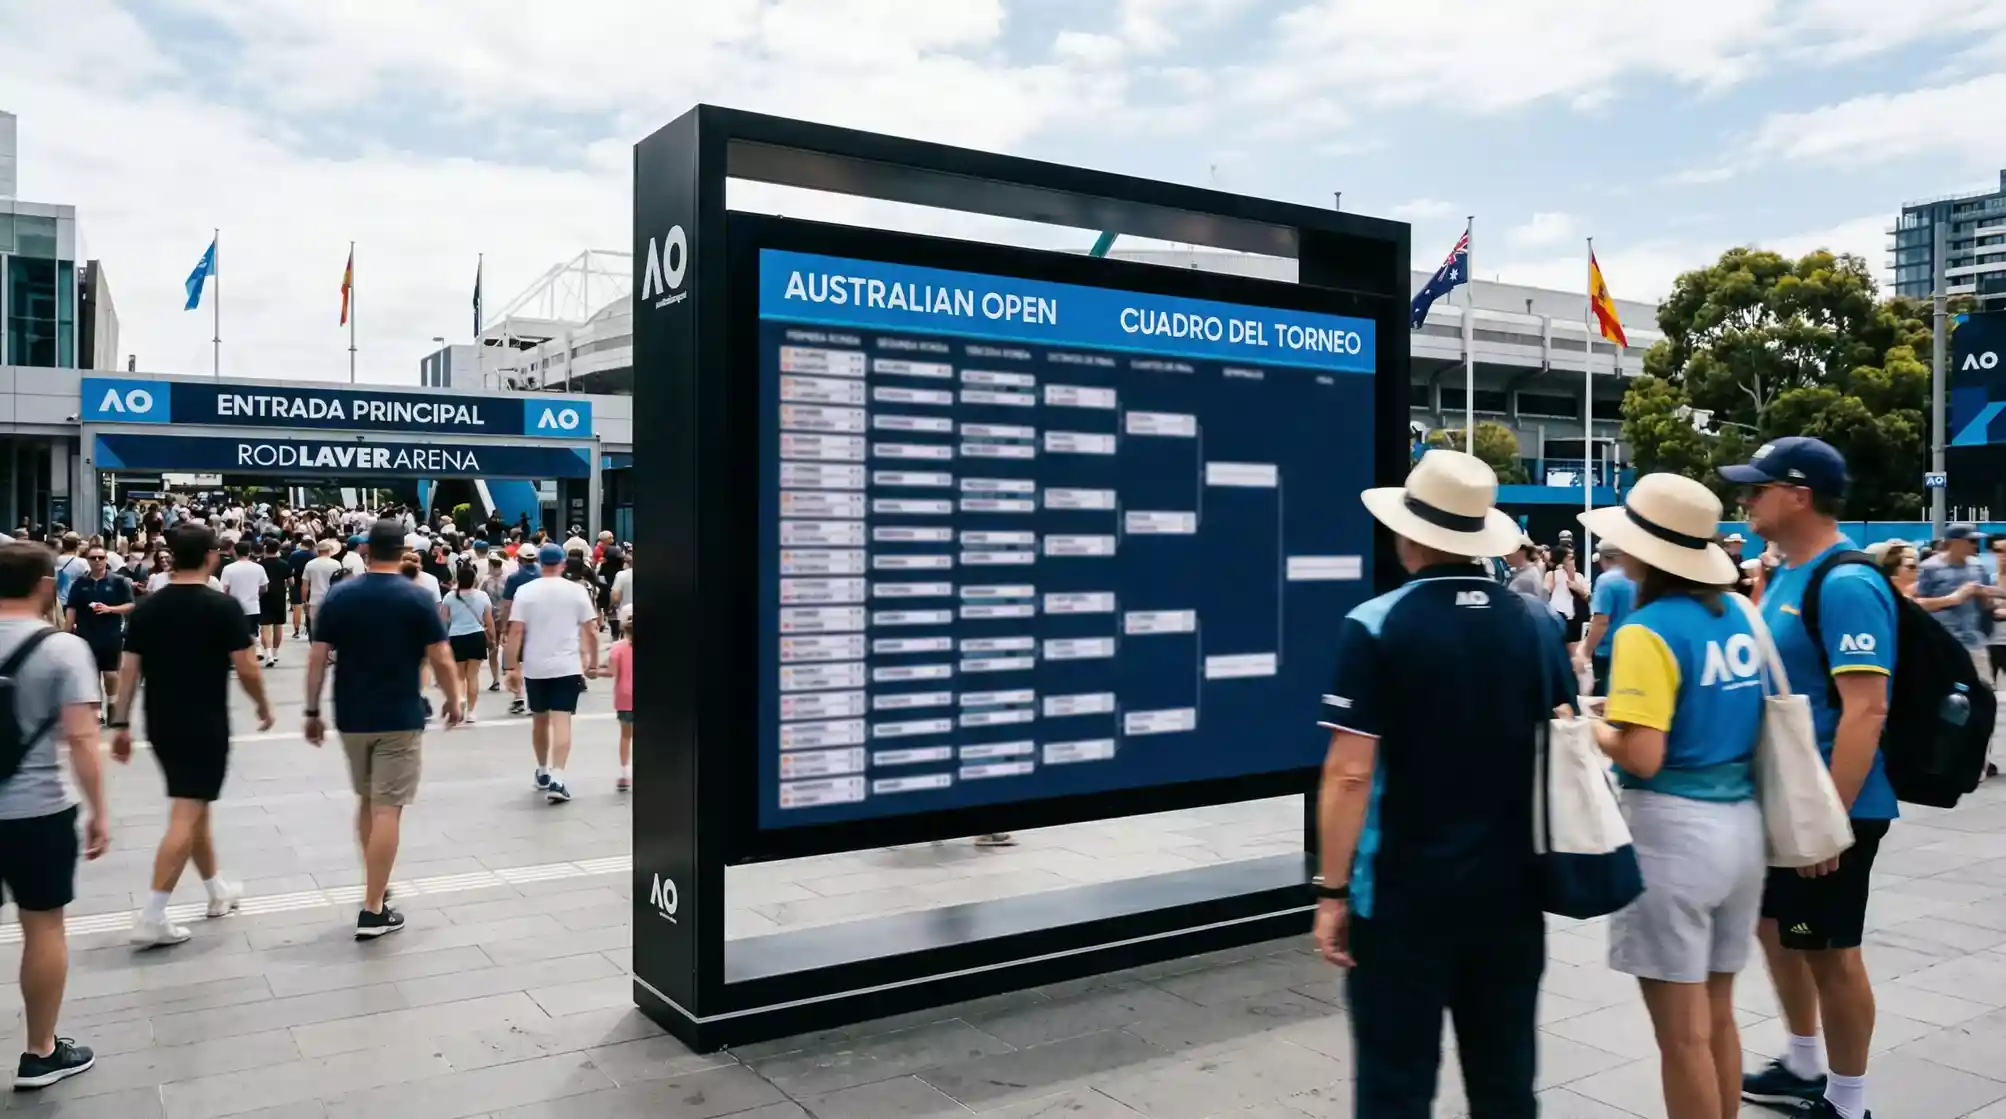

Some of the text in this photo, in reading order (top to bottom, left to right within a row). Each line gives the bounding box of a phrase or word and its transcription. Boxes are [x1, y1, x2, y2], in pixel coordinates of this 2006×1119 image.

[642, 225, 687, 300] AO
[786, 272, 1055, 324] AUSTRALIAN OPEN
[1121, 308, 1360, 354] CUADRO DEL TORNEO
[1962, 352, 1998, 370] AO
[100, 390, 152, 412] AO
[218, 394, 485, 425] ENTRADA PRINCIPAL
[538, 408, 579, 430] AO
[1926, 476, 1944, 486] AO
[1840, 634, 1874, 650] AO
[1700, 633, 1761, 686] AO
[651, 873, 677, 914] AO
